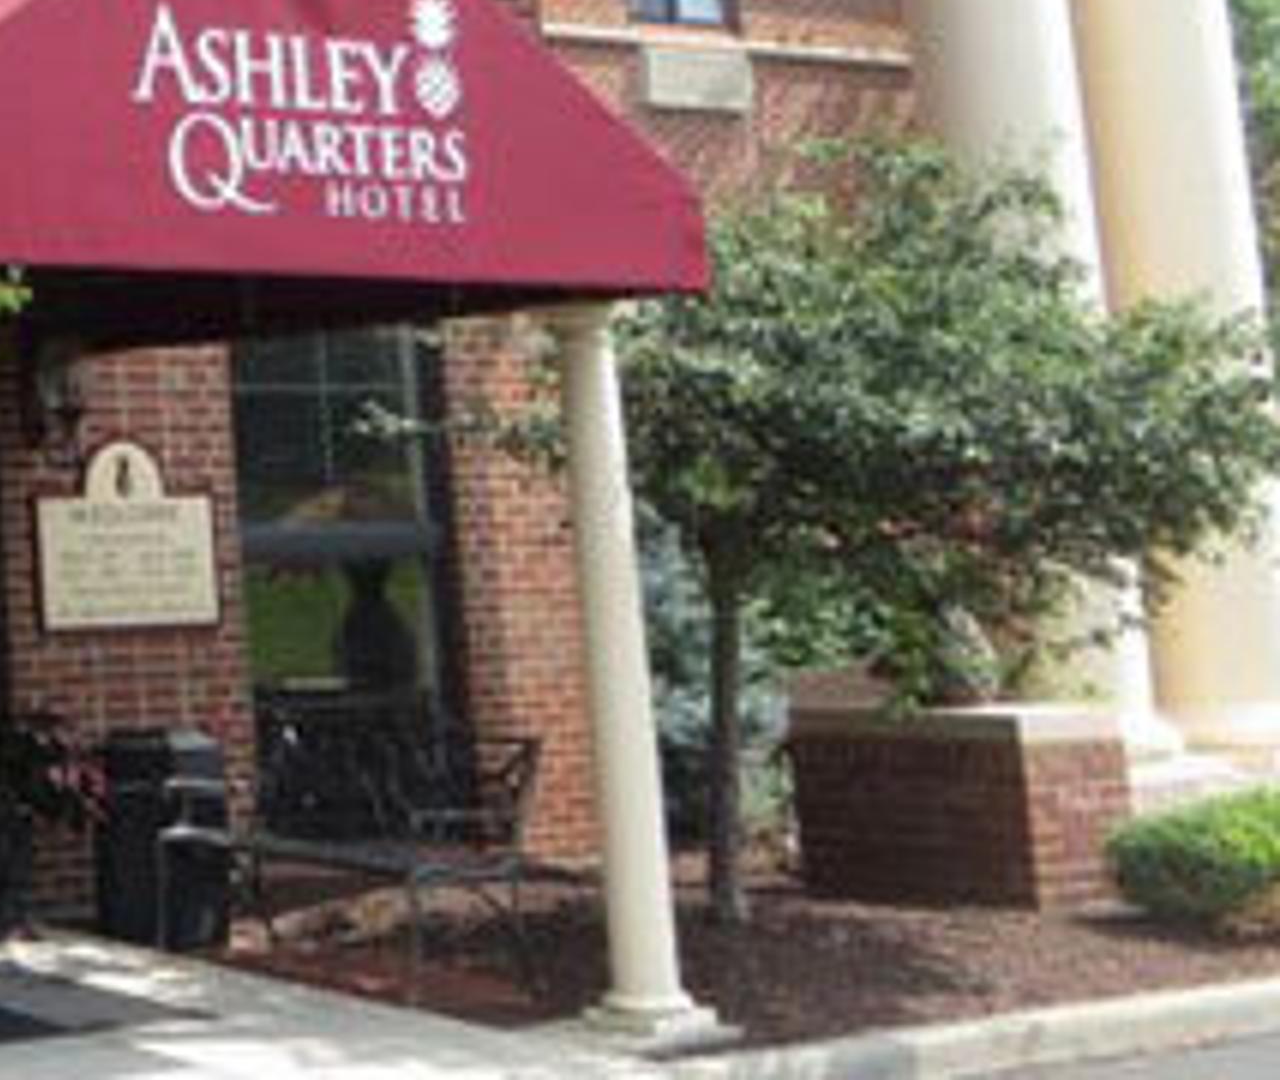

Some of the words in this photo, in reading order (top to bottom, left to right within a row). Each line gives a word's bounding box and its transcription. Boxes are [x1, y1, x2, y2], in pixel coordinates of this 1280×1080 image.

[131, 1, 411, 116] ASHLEY
[168, 111, 468, 213] QUARTERS
[325, 182, 466, 223] HOTEL
